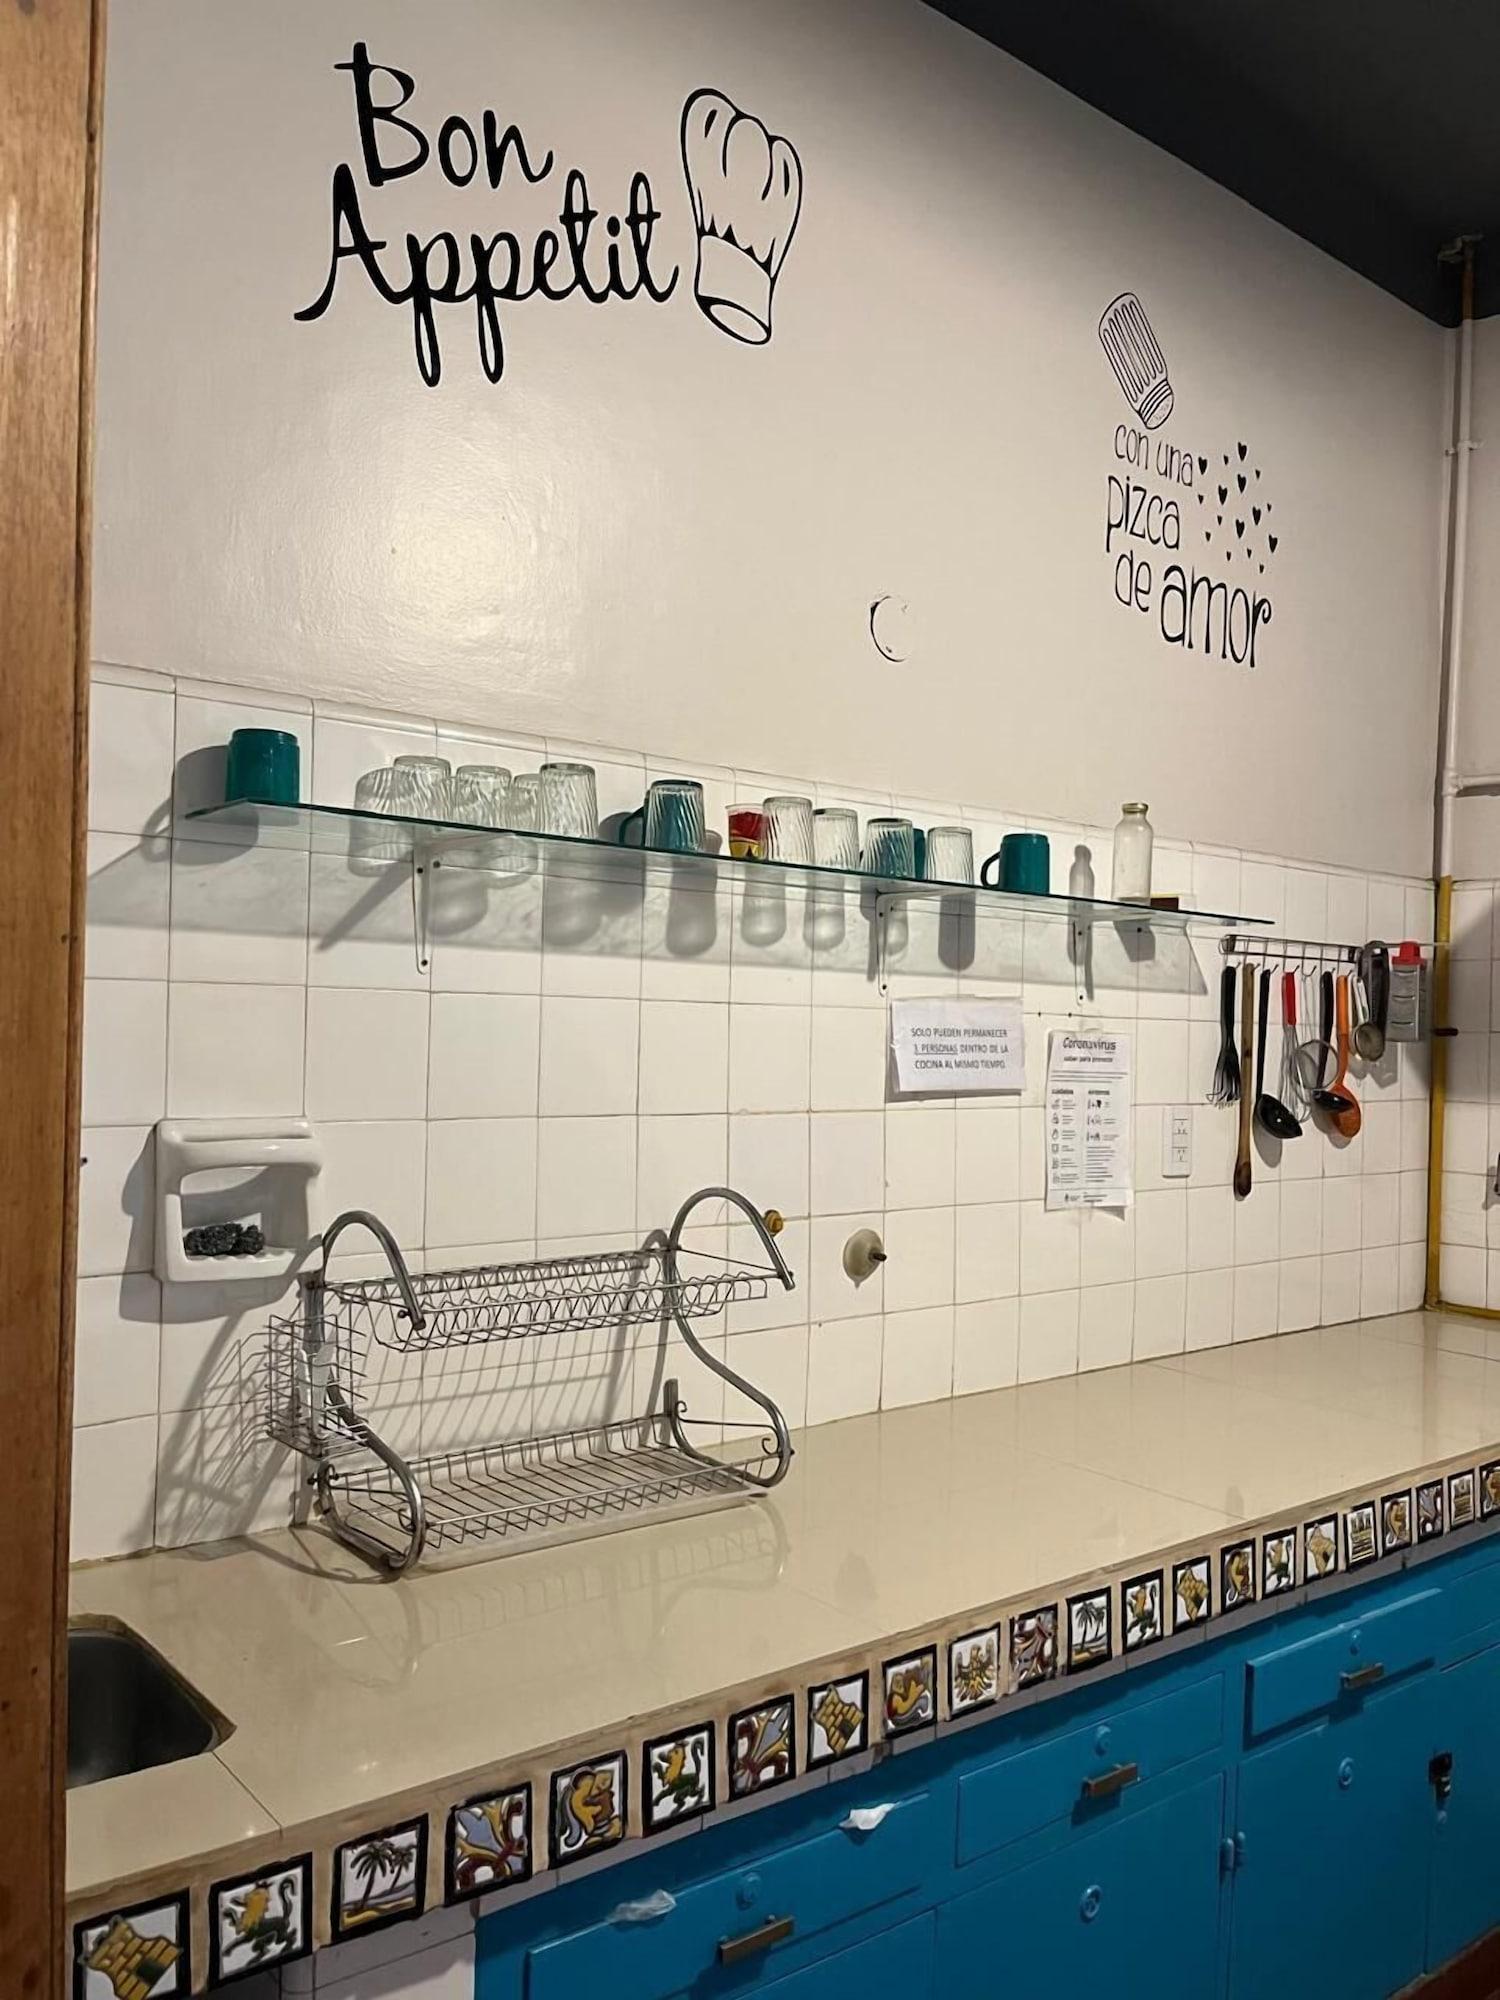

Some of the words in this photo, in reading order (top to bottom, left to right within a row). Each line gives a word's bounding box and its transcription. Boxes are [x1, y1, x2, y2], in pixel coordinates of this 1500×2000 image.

[333, 41, 554, 190] Bon
[293, 163, 680, 388] Appetit
[1115, 424, 1150, 471] con
[1156, 439, 1194, 487] una
[1106, 475, 1181, 553] pizca
[1115, 549, 1152, 613] de
[1160, 564, 1272, 668] amor
[911, 1028, 932, 1037] SOLO
[933, 1028, 962, 1037] PUEDEN
[963, 1029, 1008, 1038] PERMANECER
[914, 1060, 943, 1069] COCINA
[944, 1060, 954, 1069] AL
[954, 1060, 980, 1069] MISMO
[921, 1043, 959, 1053] PERSONAS
[959, 1044, 988, 1053] DENTRO
[989, 1044, 999, 1053] DE
[1000, 1044, 1009, 1053] LA
[1062, 1037, 1117, 1051] Coronavirus
